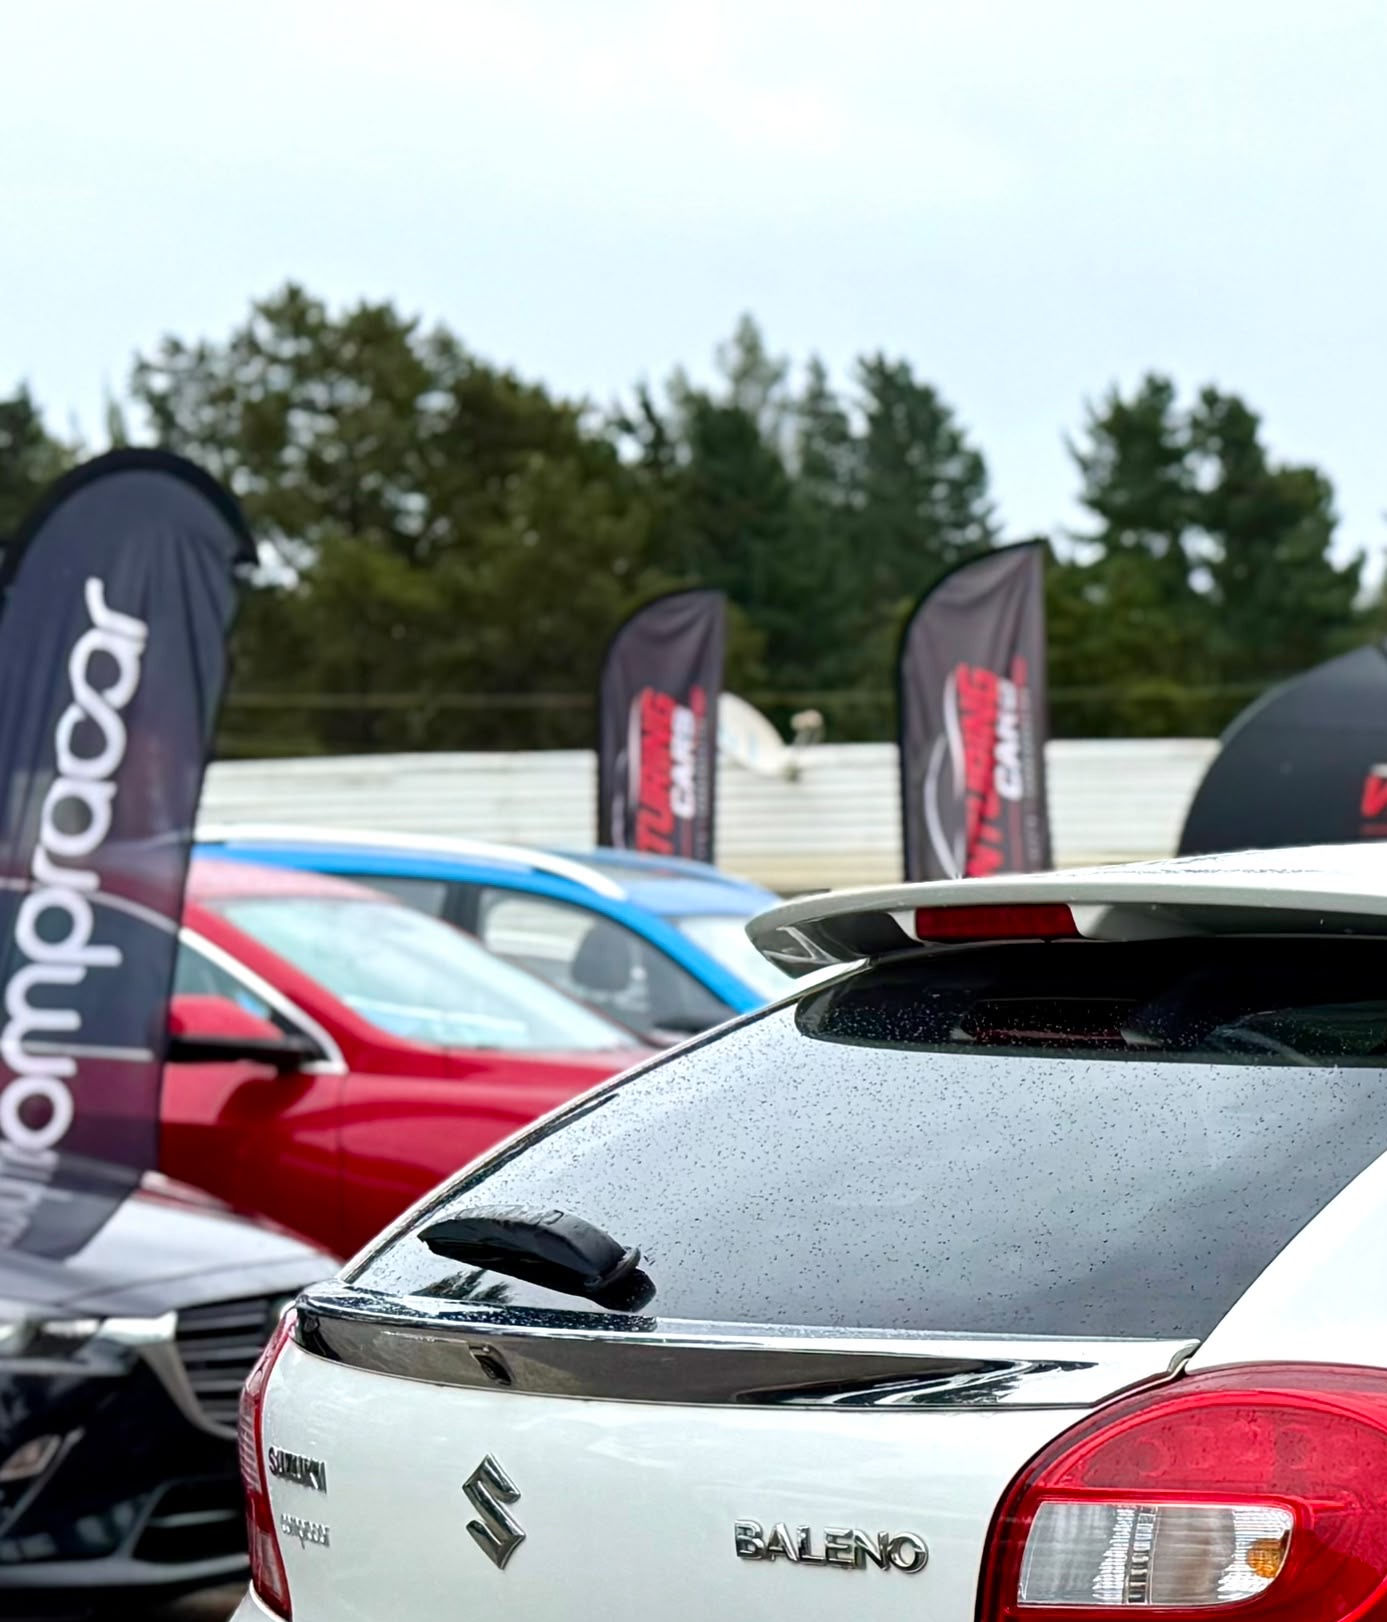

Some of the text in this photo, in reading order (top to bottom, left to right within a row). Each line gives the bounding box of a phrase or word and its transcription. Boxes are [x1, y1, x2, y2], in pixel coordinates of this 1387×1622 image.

[635, 686, 677, 856] TURING
[955, 662, 1004, 878] NTURING
[0, 576, 148, 1162] ompracar
[734, 1519, 928, 1574] BALENO
